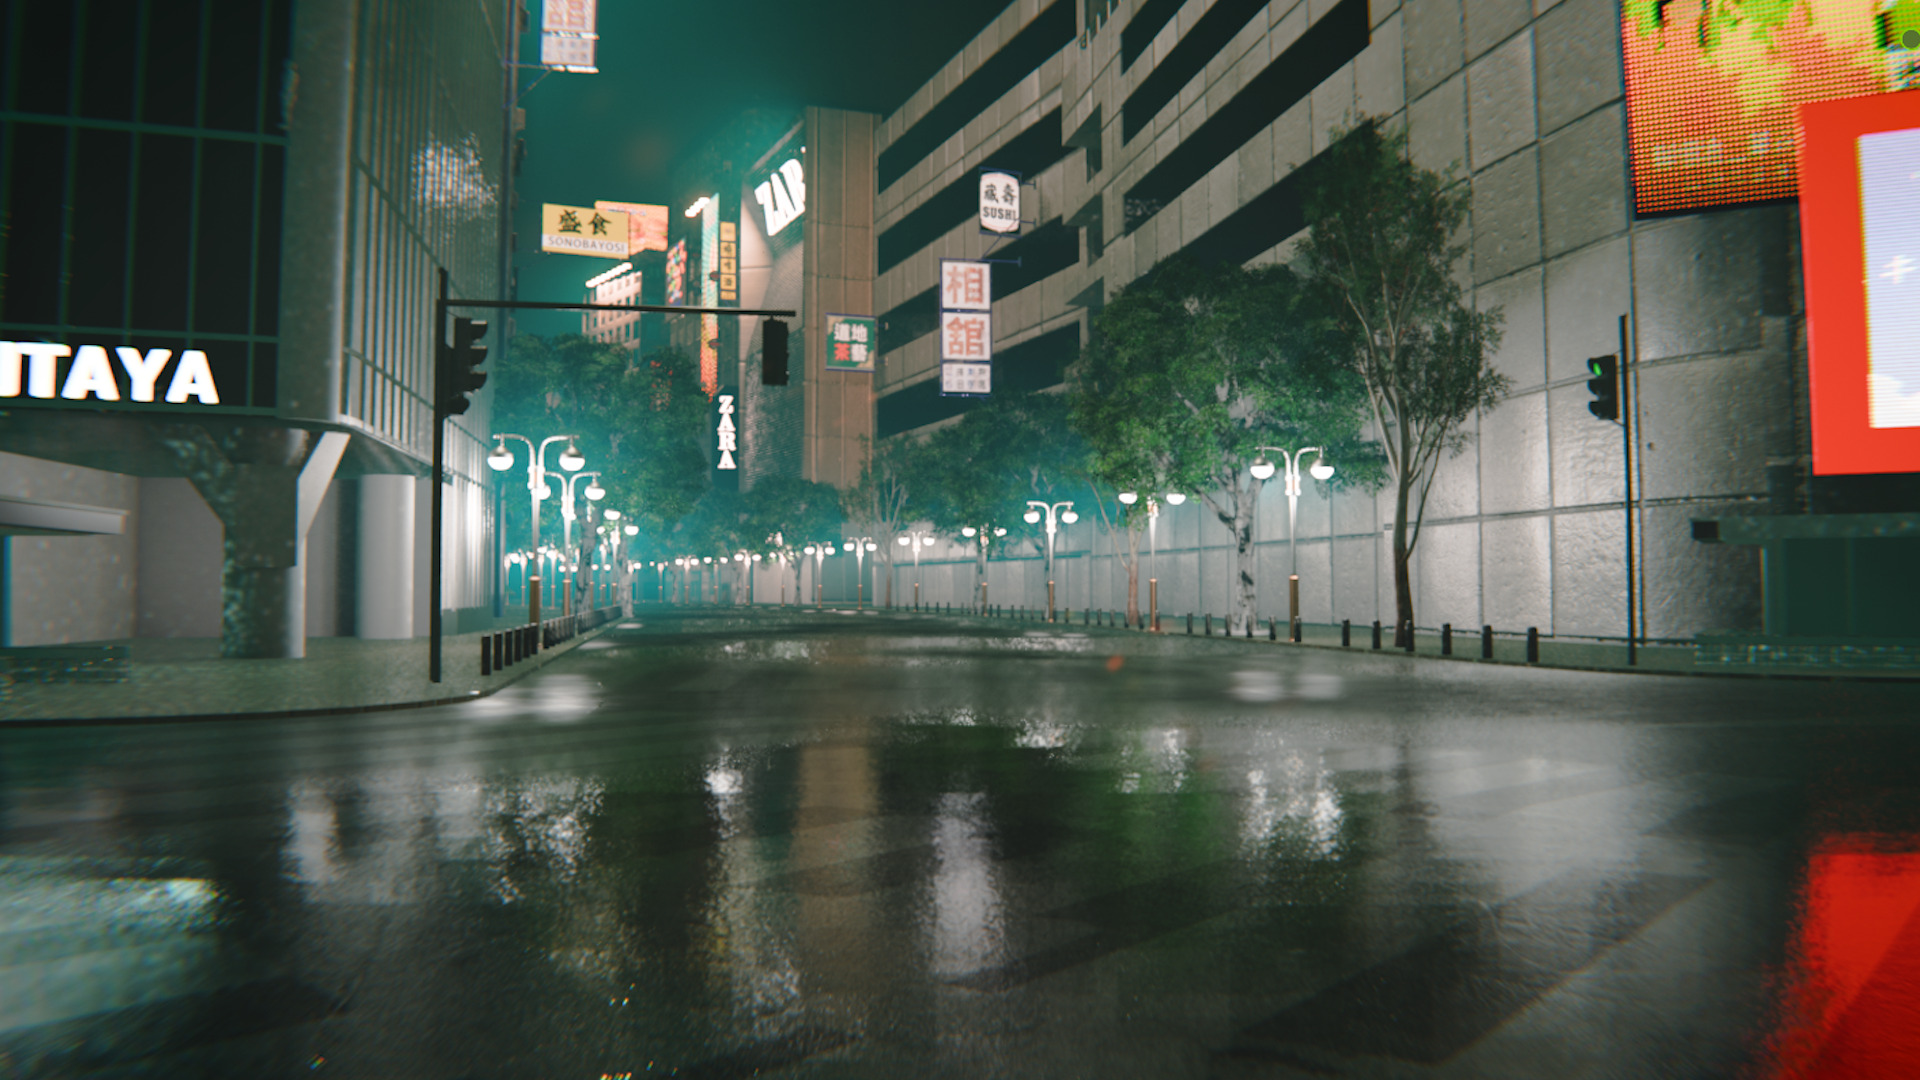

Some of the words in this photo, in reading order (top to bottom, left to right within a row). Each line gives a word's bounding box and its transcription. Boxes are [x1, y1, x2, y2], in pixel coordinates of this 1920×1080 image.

[982, 206, 1018, 222] SUSHI
[548, 235, 626, 253] SONOBAYOSI
[717, 394, 737, 470] ZARA
